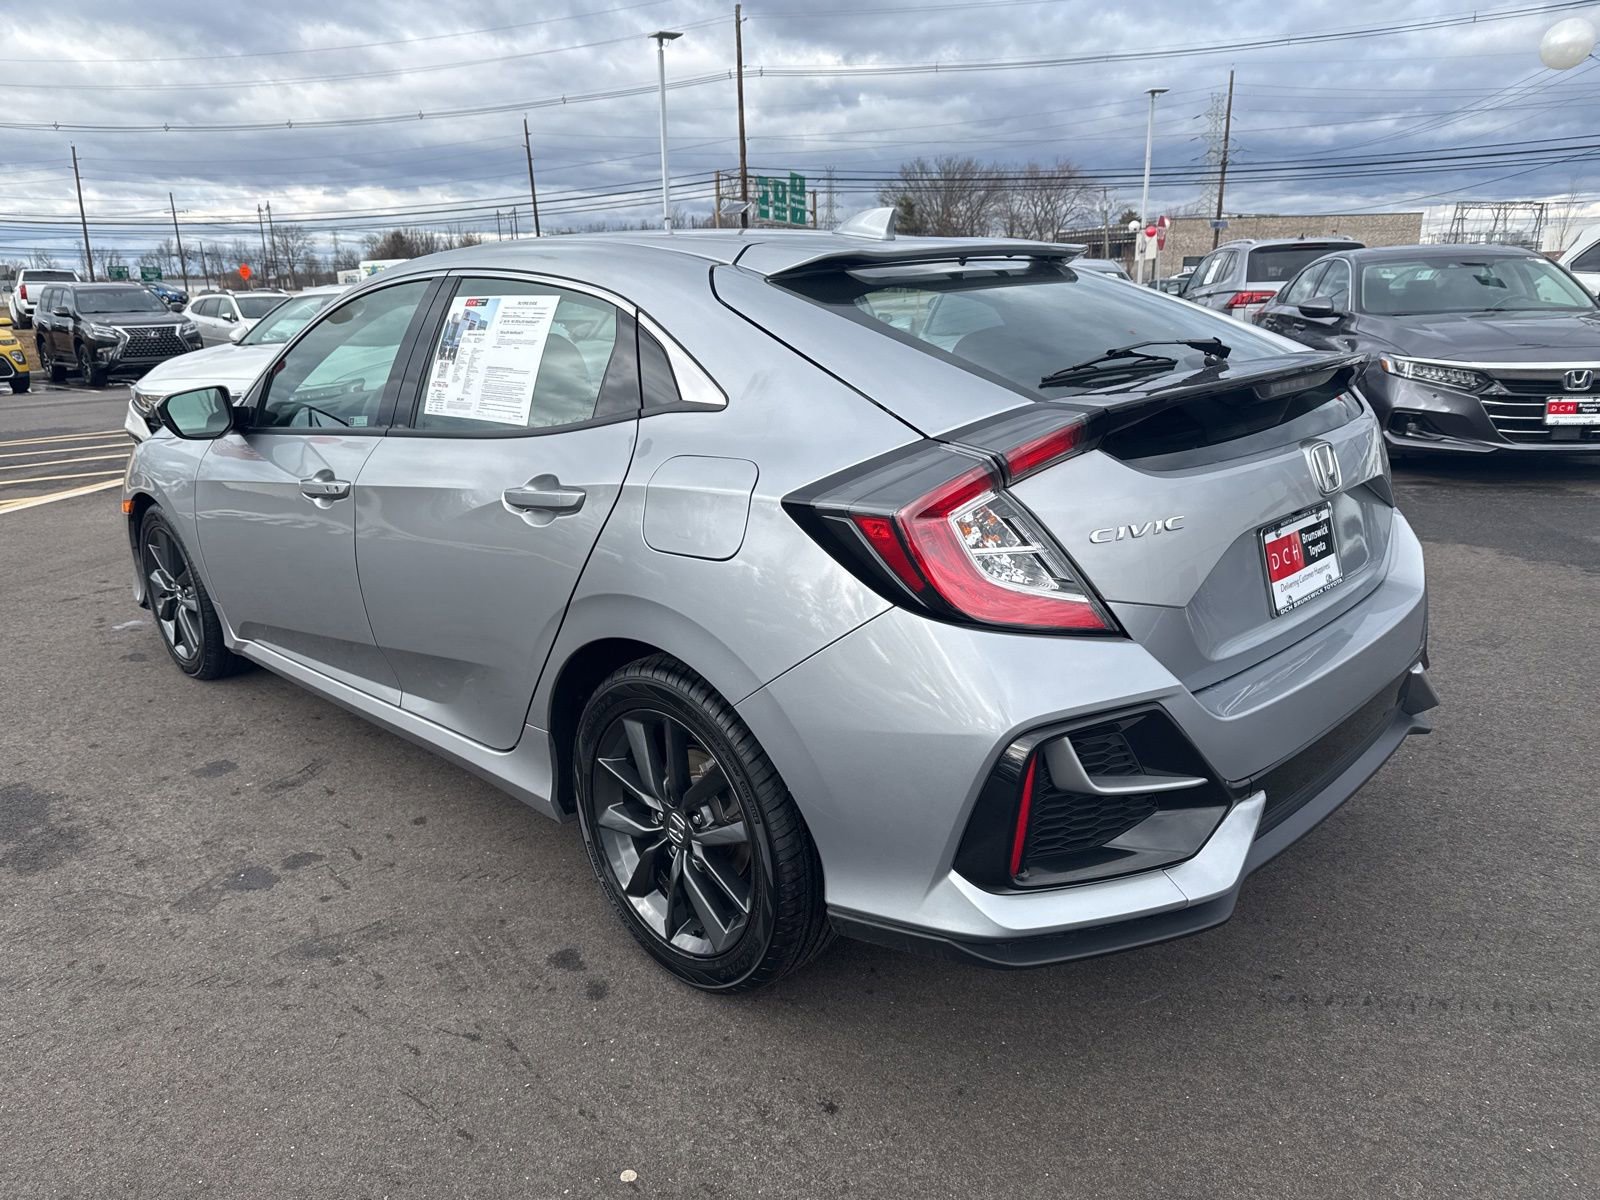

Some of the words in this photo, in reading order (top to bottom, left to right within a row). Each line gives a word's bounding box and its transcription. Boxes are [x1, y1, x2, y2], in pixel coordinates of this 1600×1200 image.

[1089, 515, 1185, 544] CIVIC
[1301, 523, 1329, 544] Brunswick
[1308, 541, 1326, 558] Toyota
[1280, 604, 1293, 615] DCH
[1294, 588, 1324, 608] BRUNSWICK
[1323, 577, 1343, 591] TOYOTA
